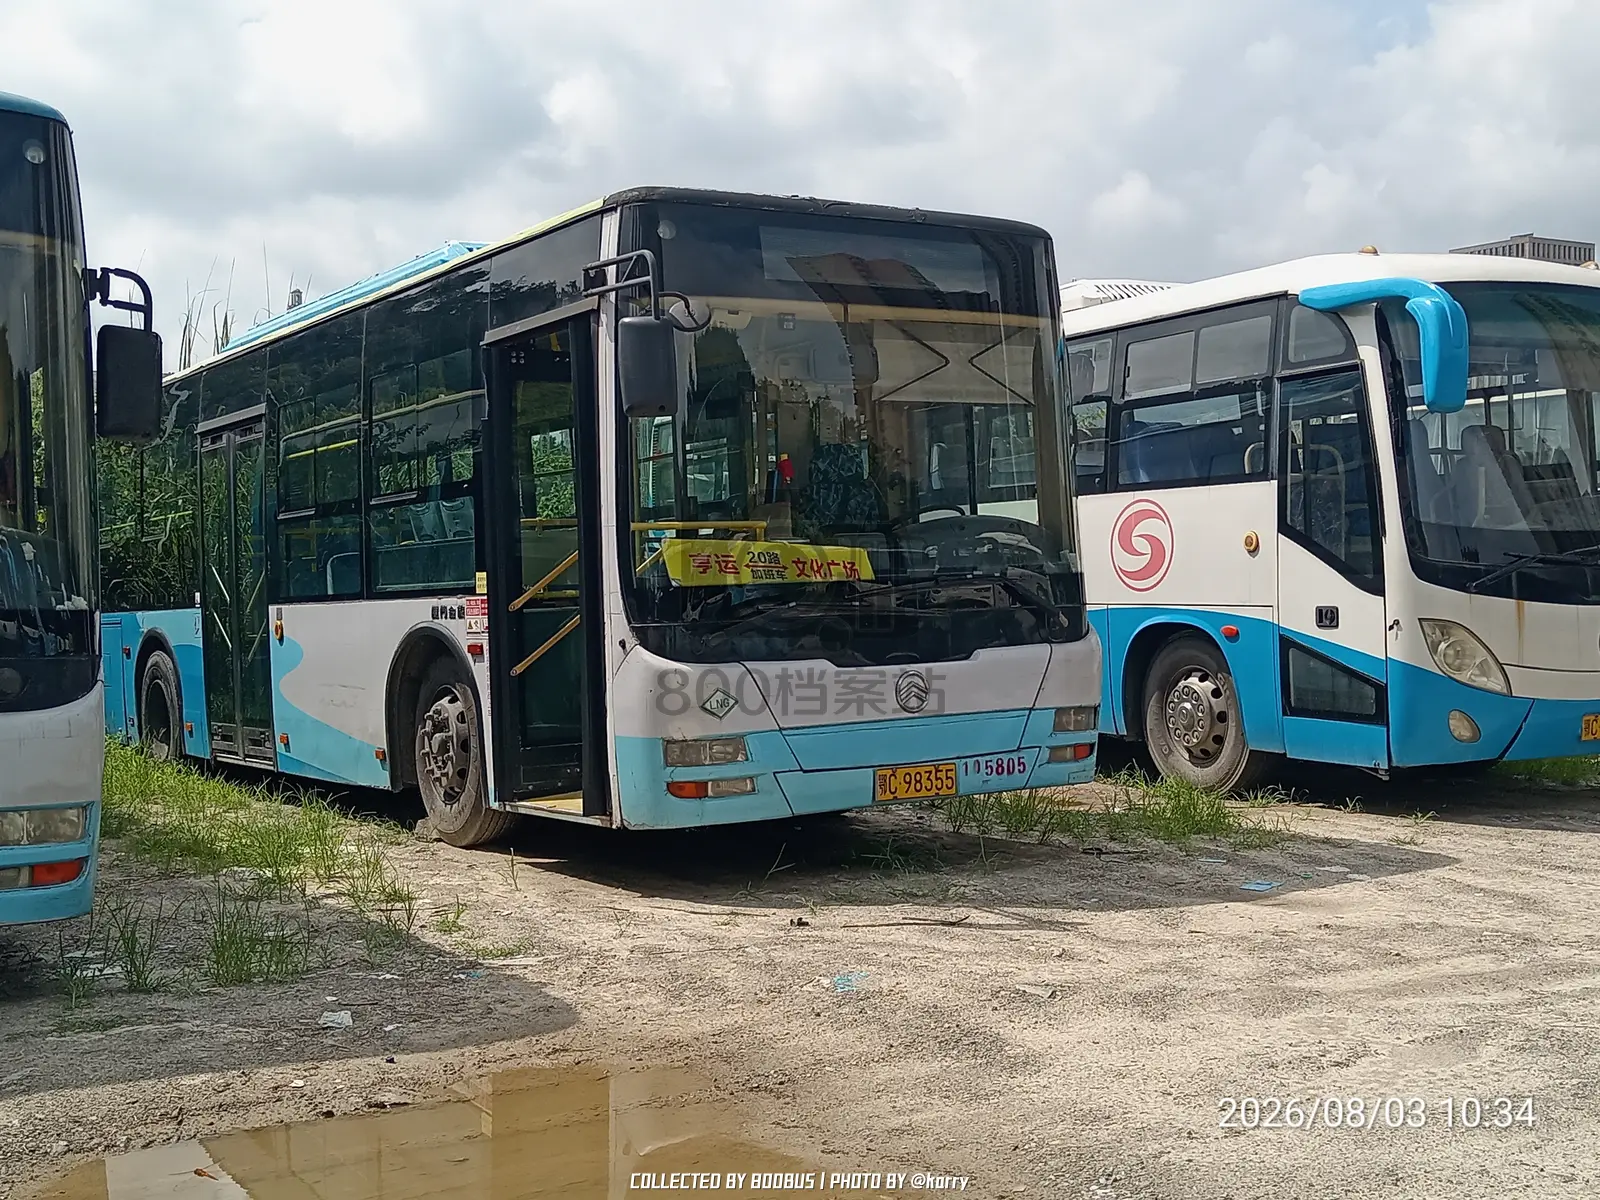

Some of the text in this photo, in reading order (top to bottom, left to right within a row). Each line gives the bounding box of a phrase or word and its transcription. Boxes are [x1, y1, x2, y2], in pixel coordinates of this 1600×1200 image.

[747, 551, 780, 565] 20路
[751, 567, 788, 580] 加班车
[791, 557, 861, 582] 文化广场
[709, 697, 730, 710] LNG
